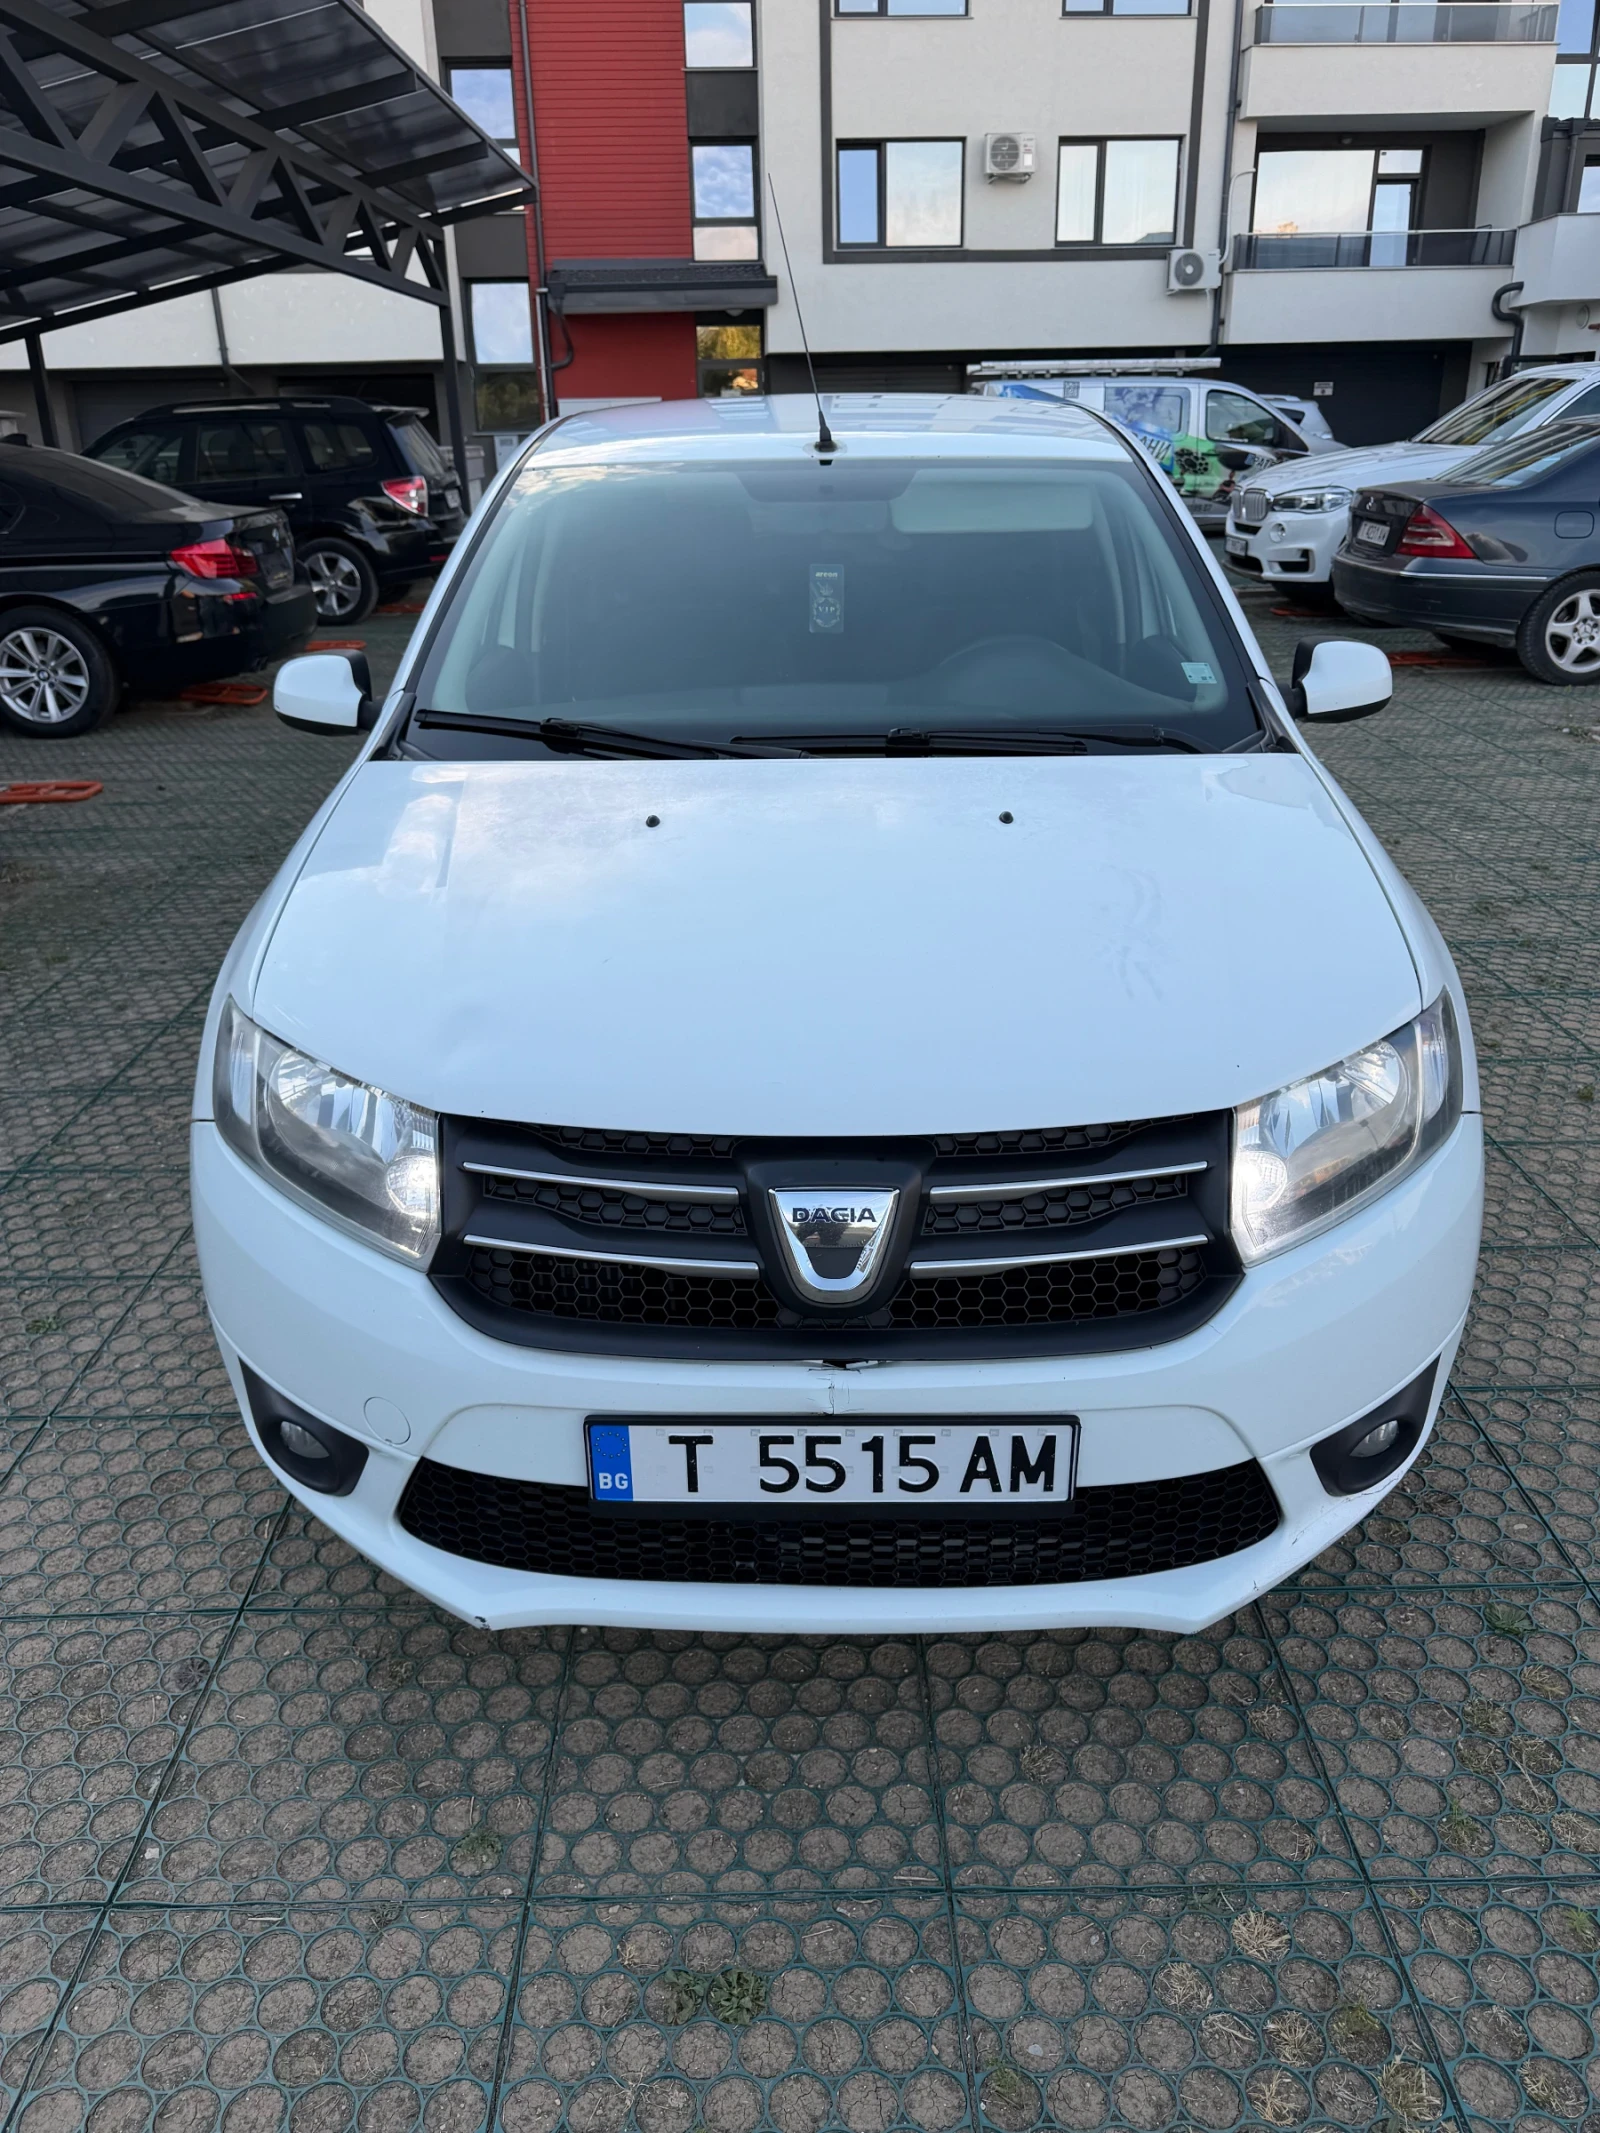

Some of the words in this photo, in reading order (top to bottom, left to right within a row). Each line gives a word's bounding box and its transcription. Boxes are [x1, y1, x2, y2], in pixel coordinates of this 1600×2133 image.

[792, 1207, 876, 1222] DACIA
[668, 1435, 714, 1493] T
[759, 1435, 939, 1493] 5515
[959, 1435, 1057, 1493] AM
[599, 1472, 628, 1489] BG
